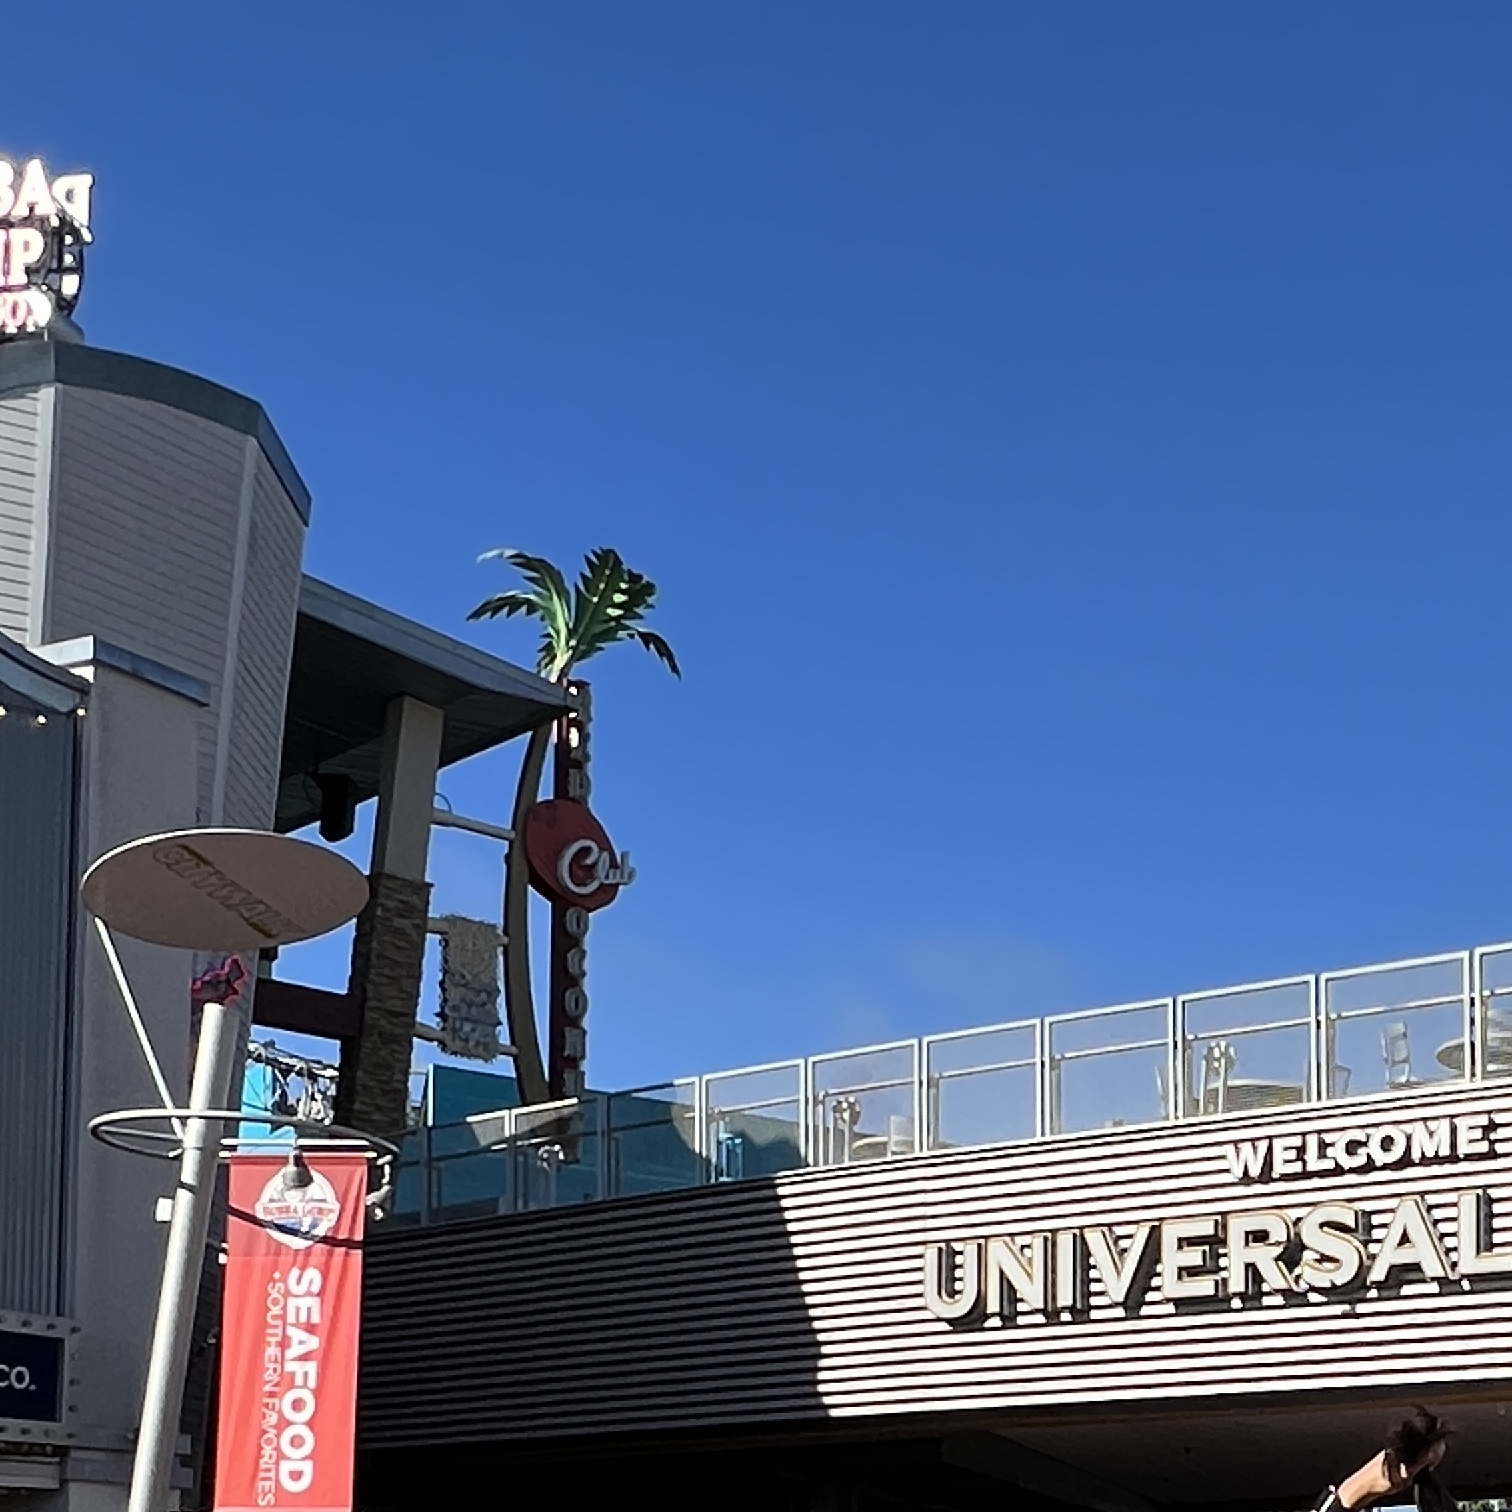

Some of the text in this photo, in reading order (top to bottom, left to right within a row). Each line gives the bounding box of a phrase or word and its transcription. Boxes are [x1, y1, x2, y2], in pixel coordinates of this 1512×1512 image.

[557, 838, 637, 894] Club
[1225, 1112, 1492, 1182] WELCOME
[256, 1280, 285, 1508] SOUTHERN FAVORITES
[278, 1265, 323, 1494] SEAFOOD
